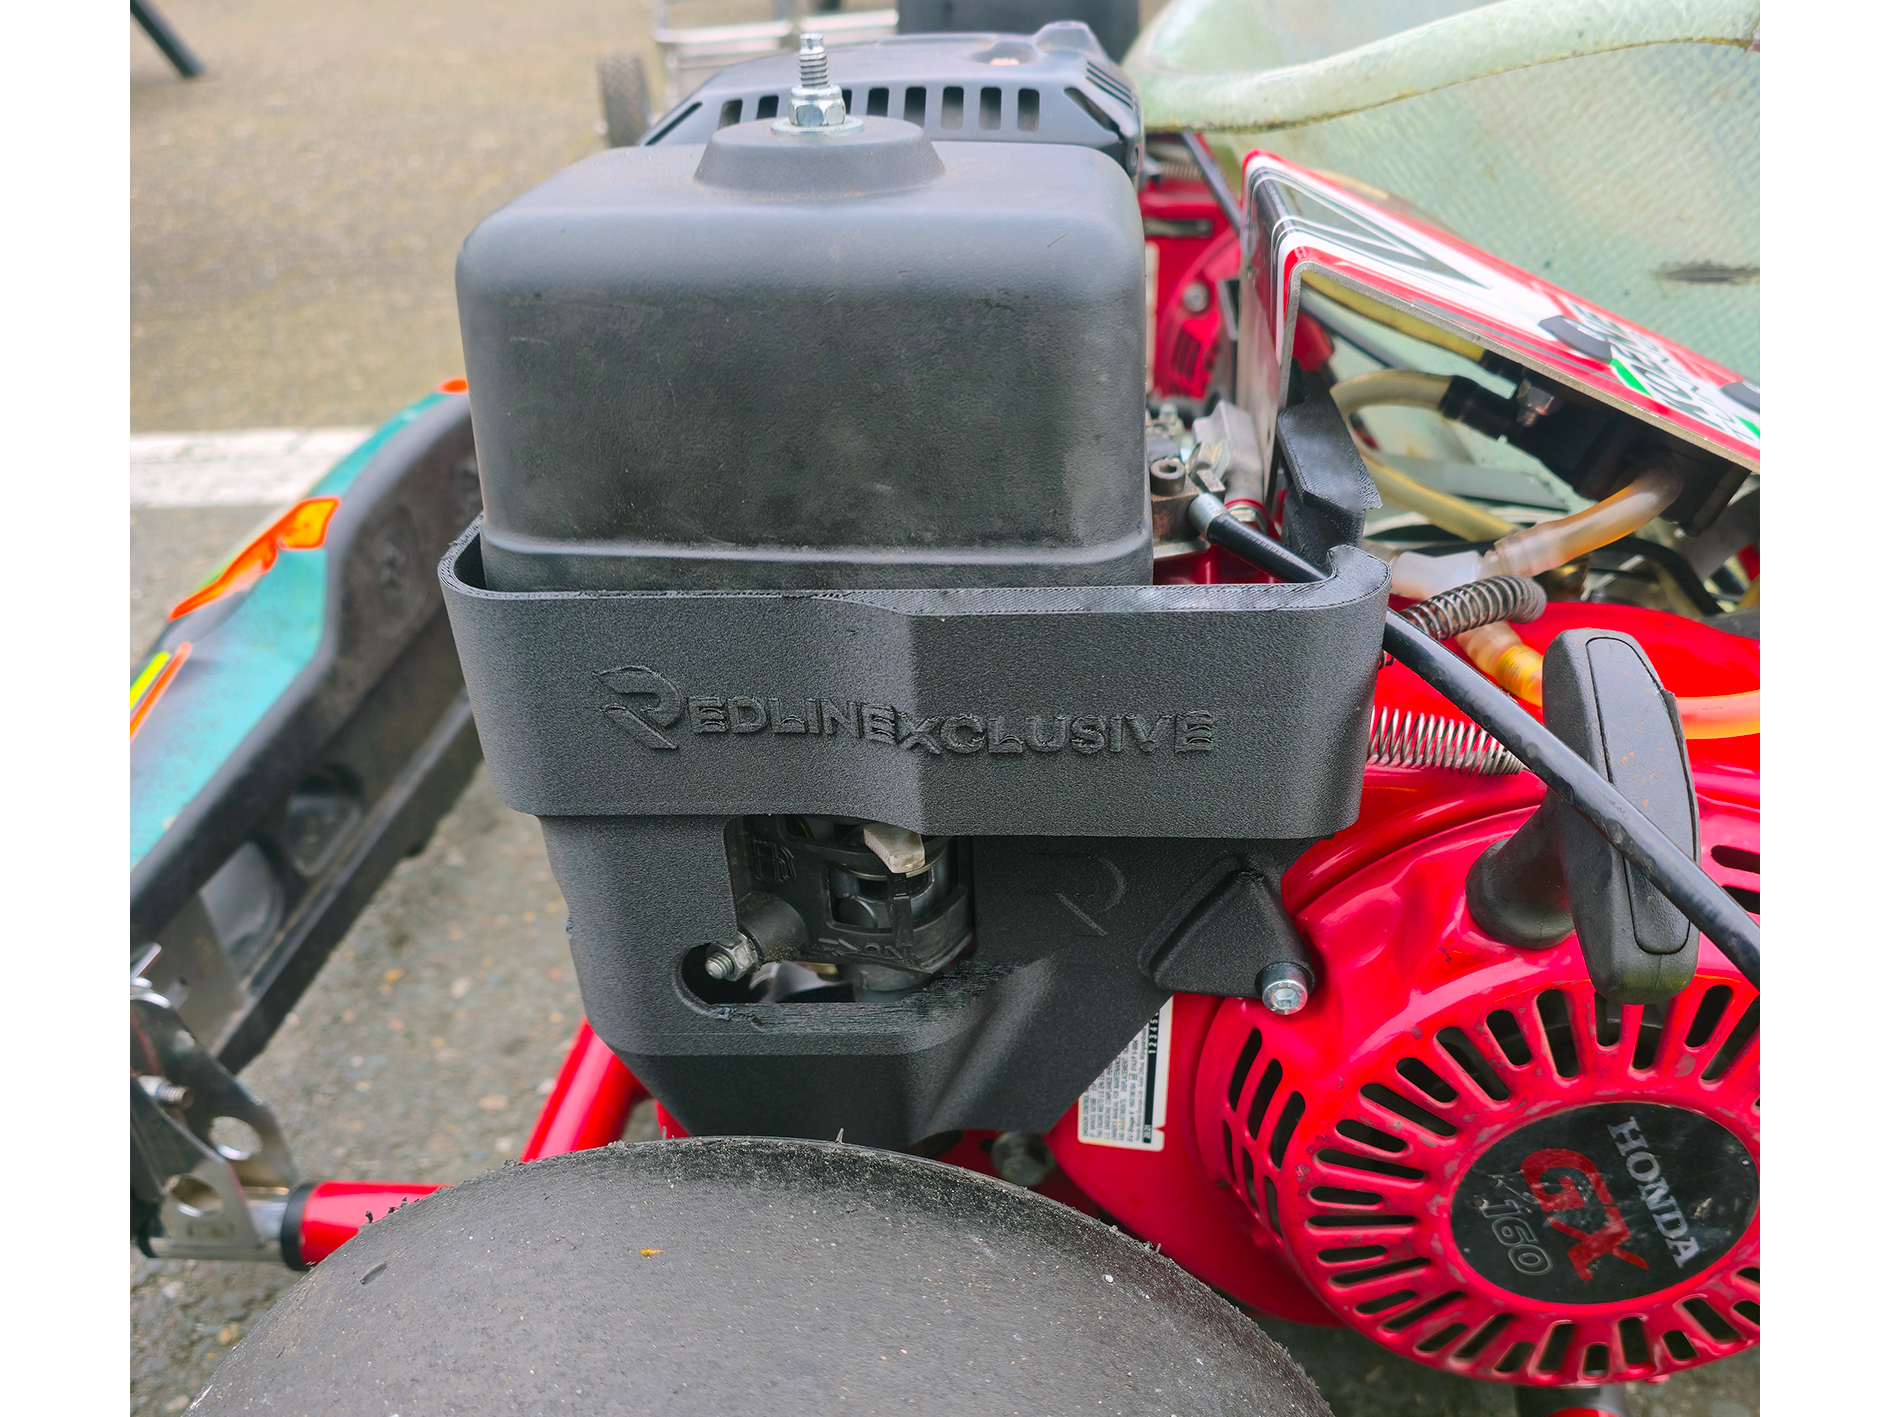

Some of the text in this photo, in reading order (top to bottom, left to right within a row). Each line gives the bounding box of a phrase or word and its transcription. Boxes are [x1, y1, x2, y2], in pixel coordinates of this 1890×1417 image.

[1478, 1198, 1554, 1276] 160
[1520, 1147, 1650, 1281] GX
[1606, 1115, 1701, 1269] HONDA
